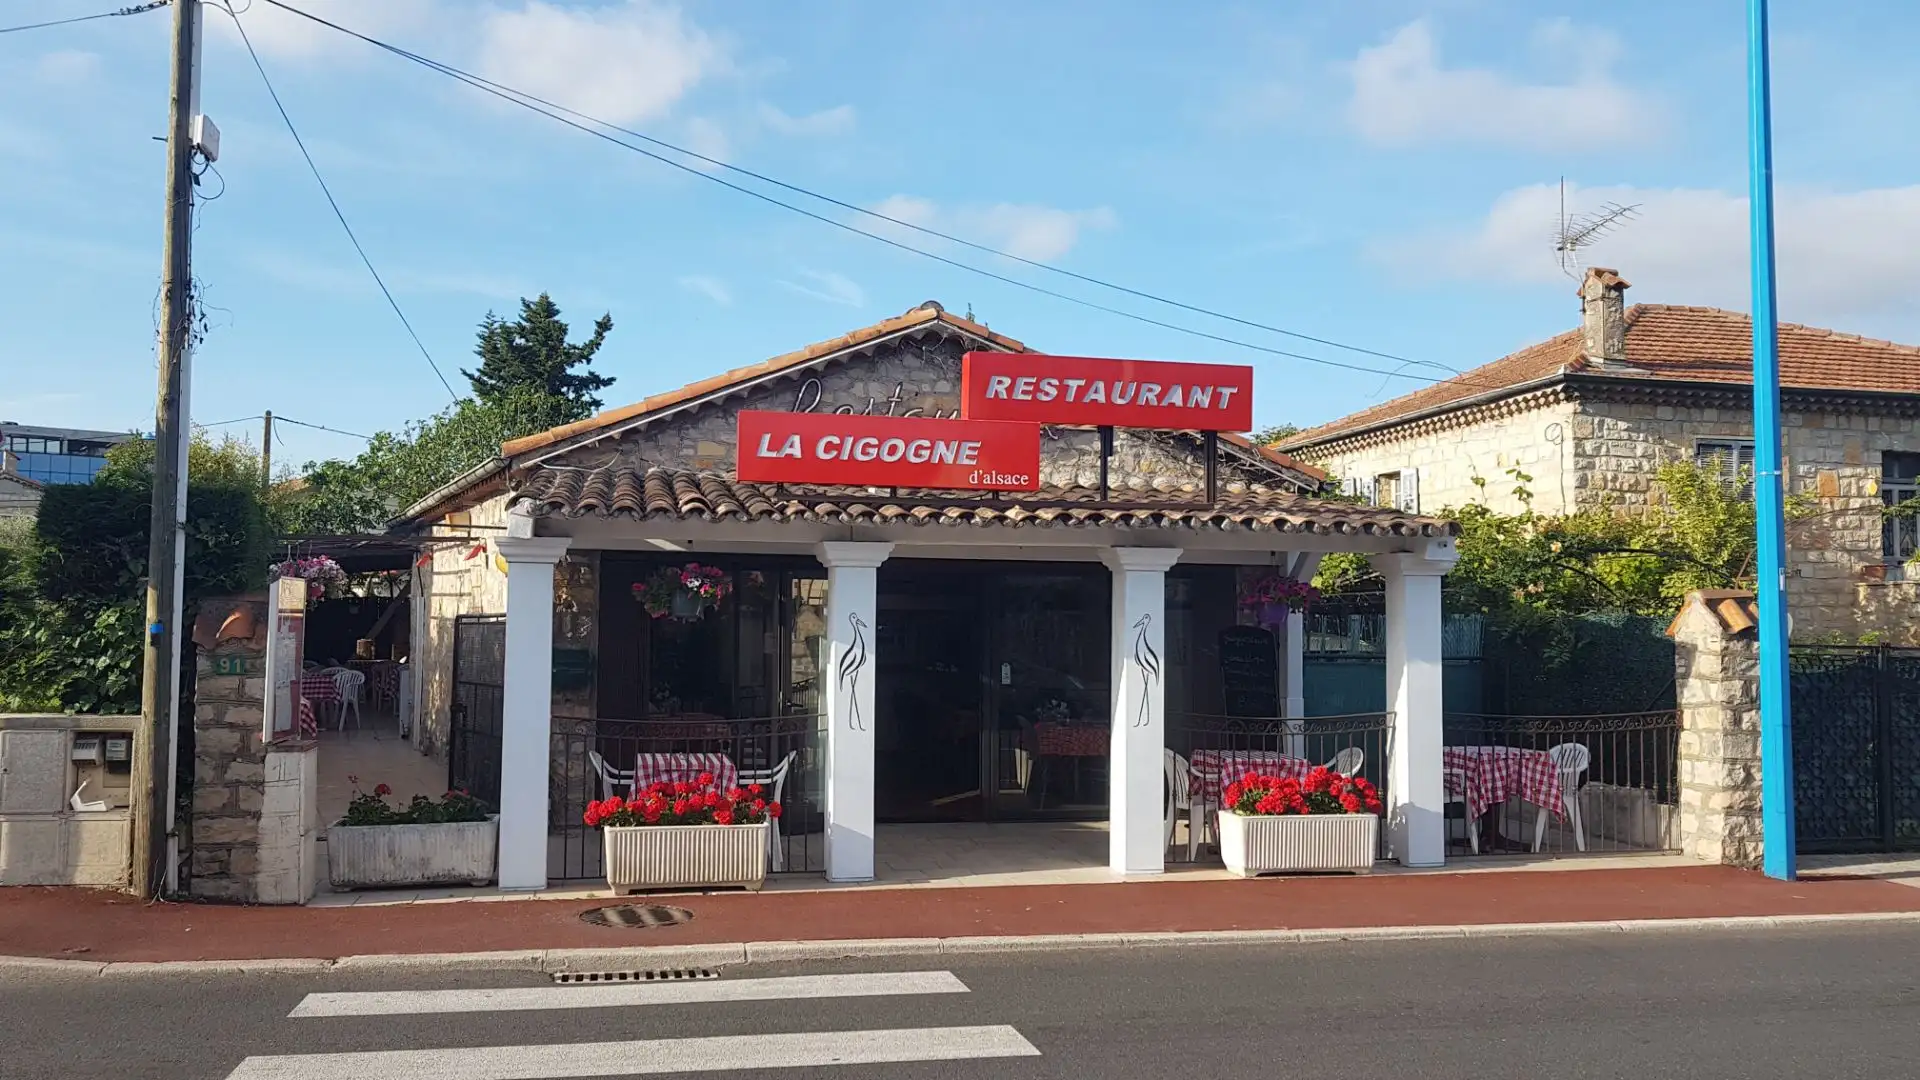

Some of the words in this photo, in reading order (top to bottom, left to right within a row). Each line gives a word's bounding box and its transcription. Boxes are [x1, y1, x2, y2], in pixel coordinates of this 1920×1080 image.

[985, 375, 1238, 409] RESTAURANT
[756, 432, 802, 459] LA
[815, 435, 982, 466] CIGOGNE
[968, 470, 1030, 486] d'alsace
[220, 658, 241, 673] 91
